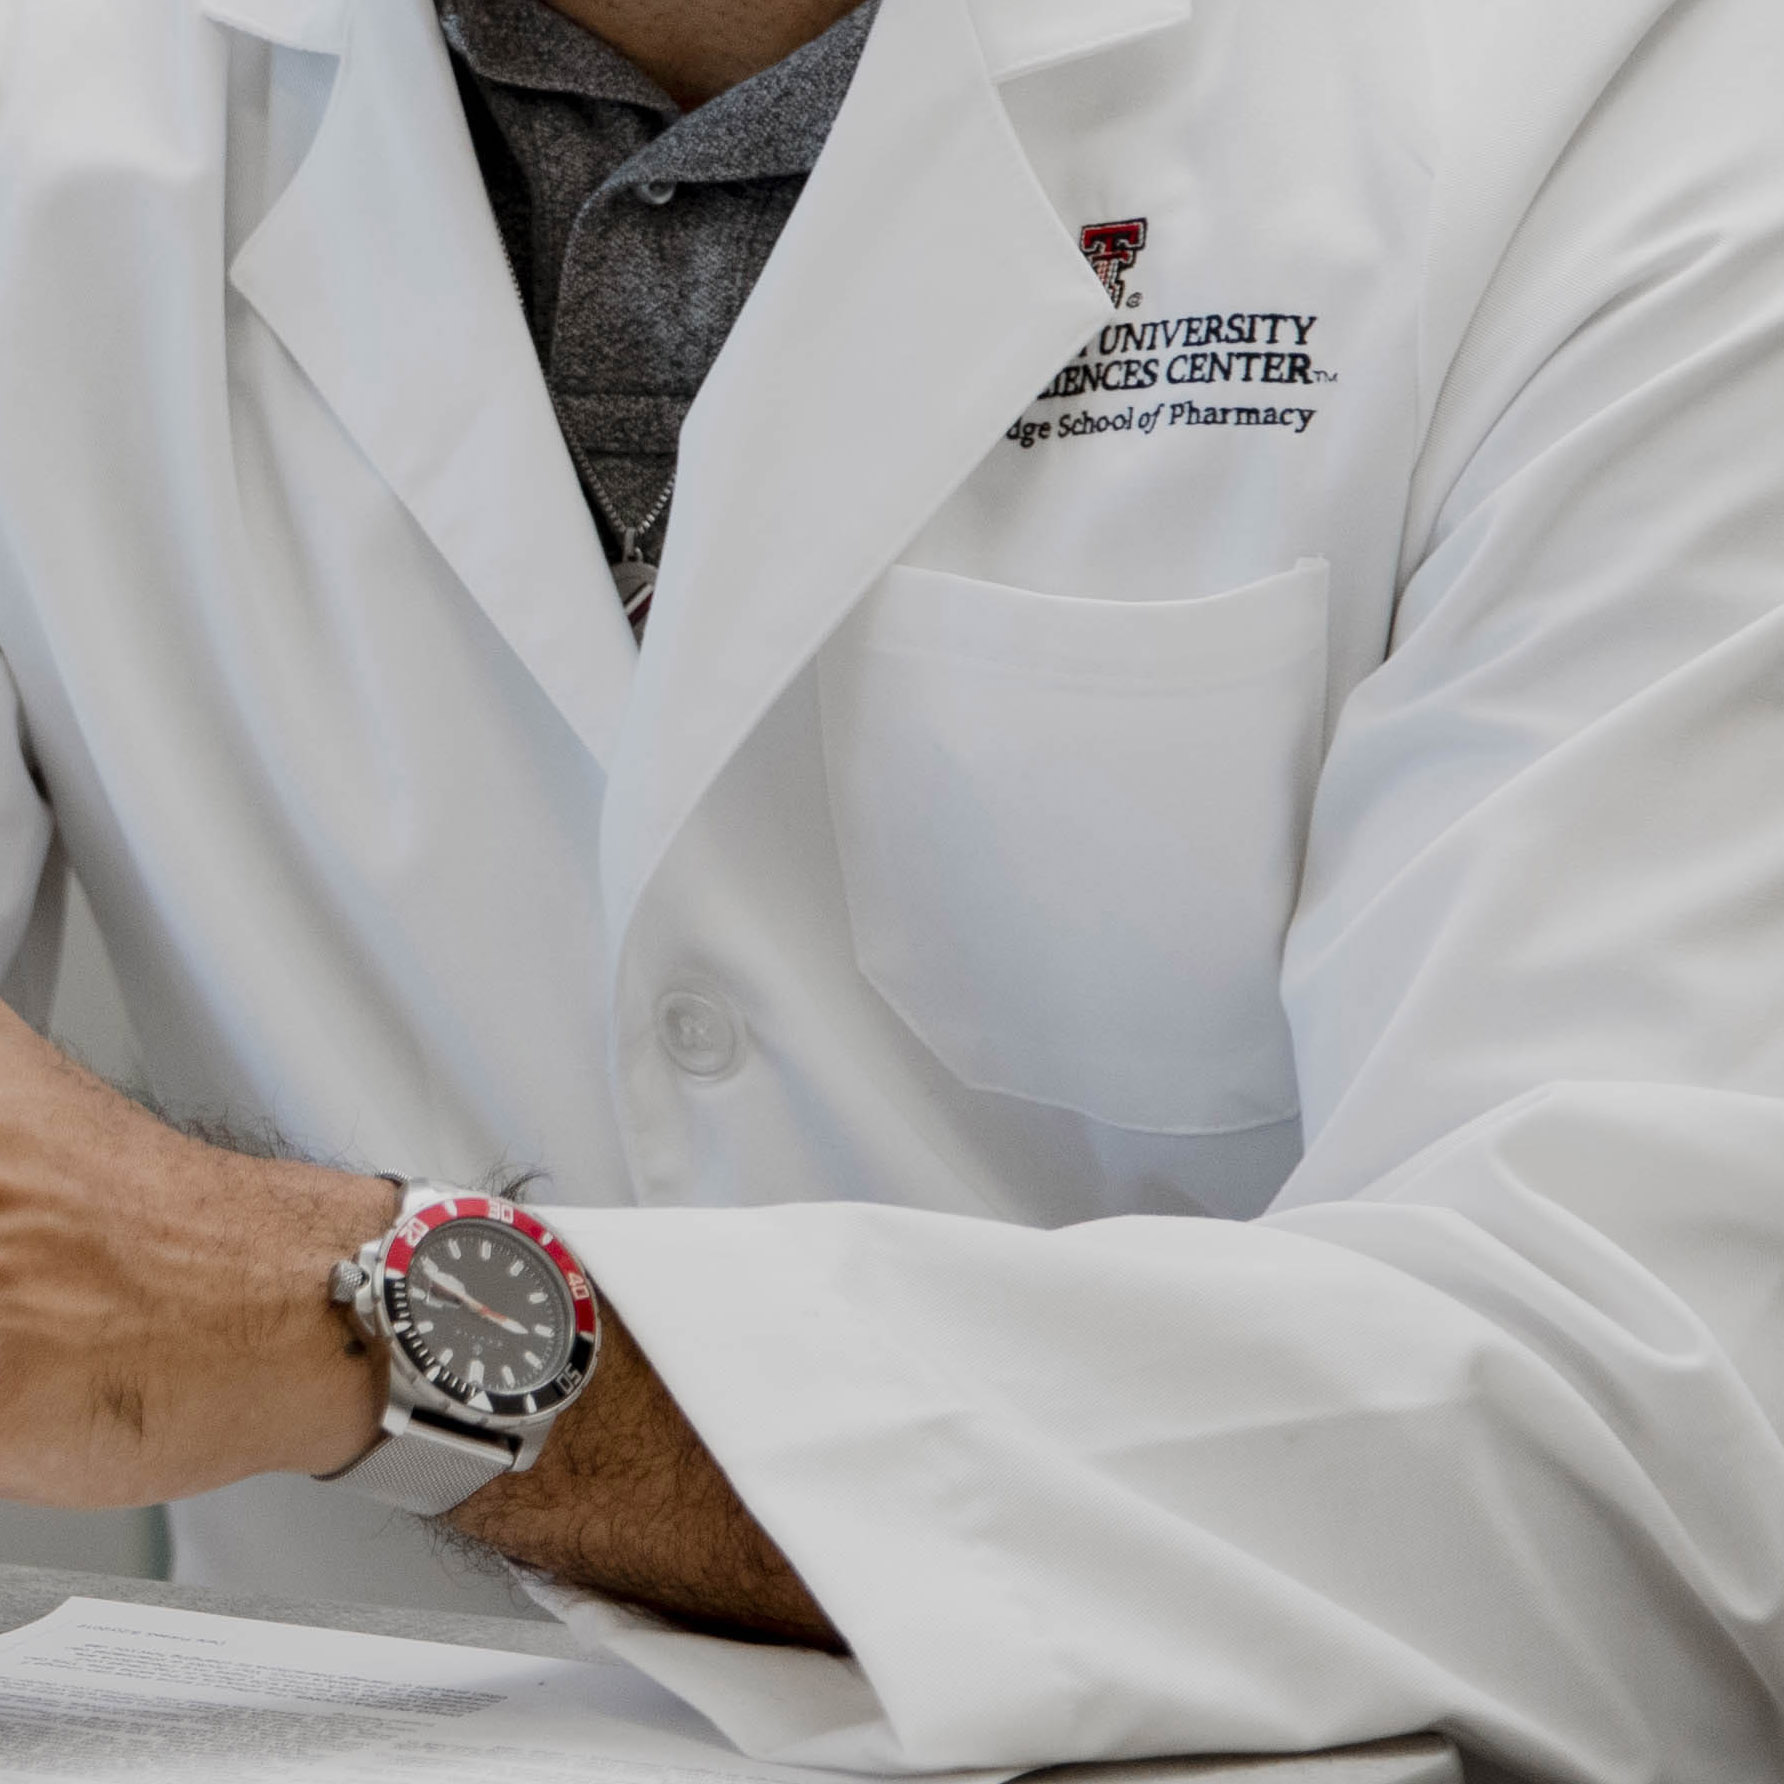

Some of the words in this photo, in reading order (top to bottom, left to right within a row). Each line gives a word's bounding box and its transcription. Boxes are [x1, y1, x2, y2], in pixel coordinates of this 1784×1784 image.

[1099, 313, 1317, 355] UNIVERSITY
[1166, 352, 1313, 384] CENTER
[1057, 406, 1134, 438] School
[1138, 403, 1165, 435] of
[1168, 400, 1317, 433] Pharmacy
[567, 1271, 590, 1301] 40
[555, 1362, 583, 1396] 50
